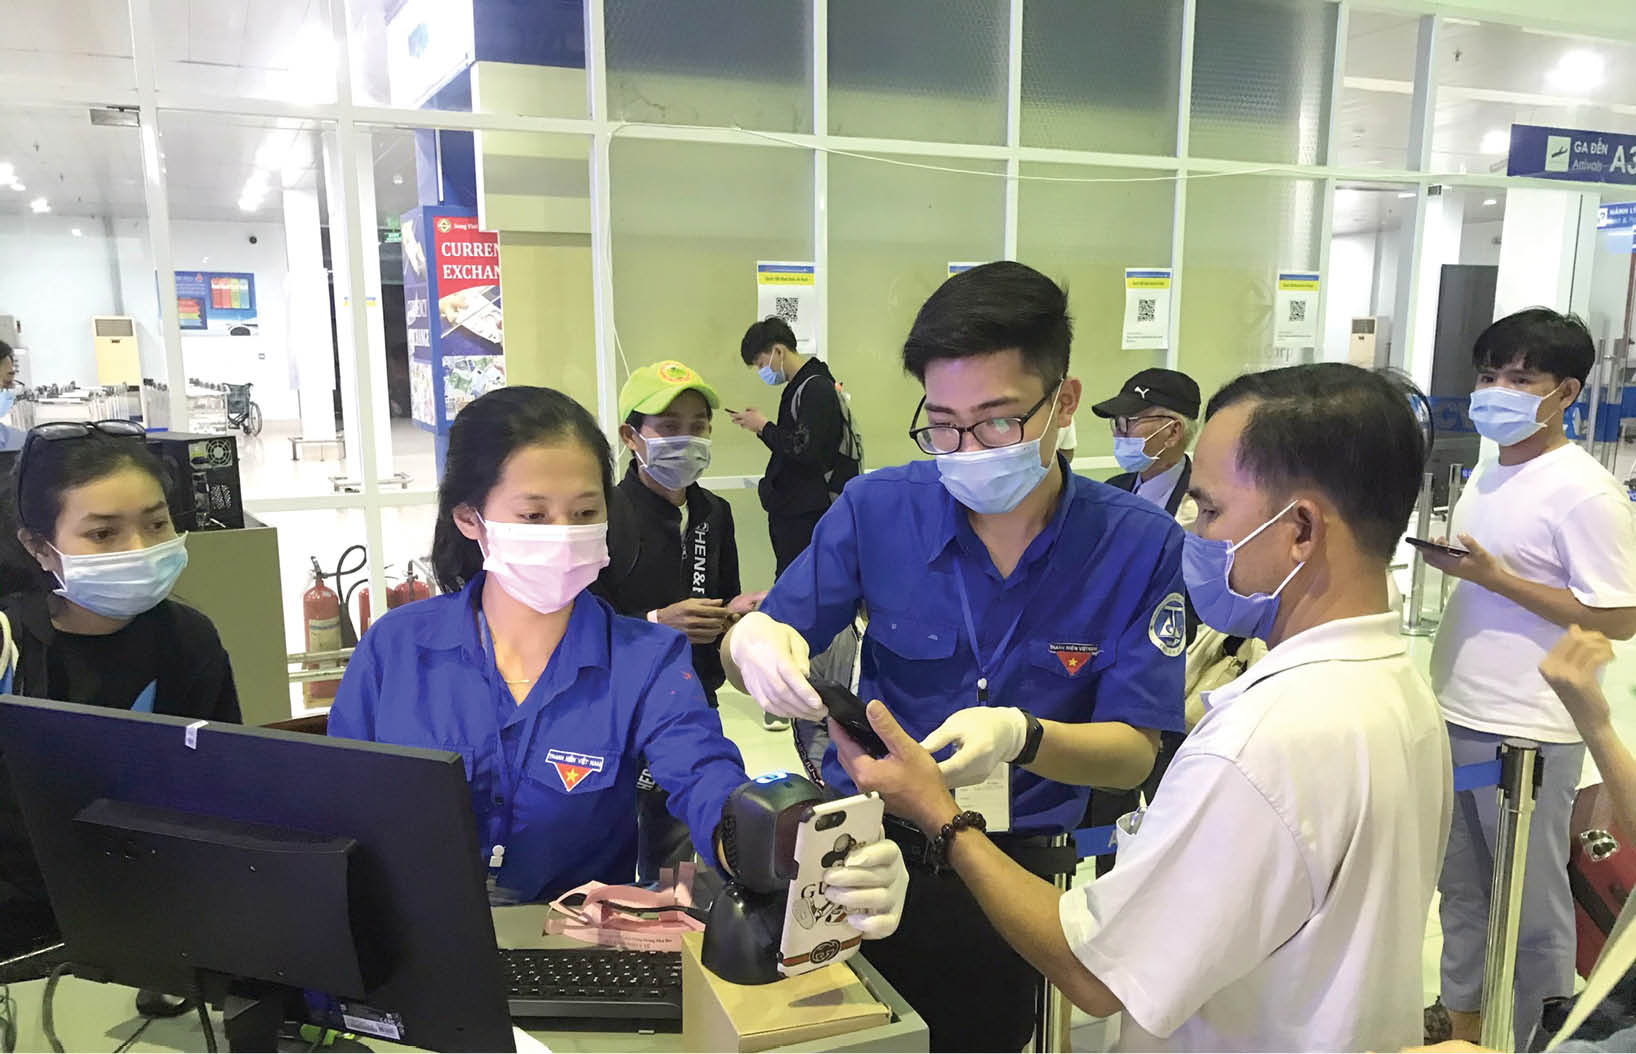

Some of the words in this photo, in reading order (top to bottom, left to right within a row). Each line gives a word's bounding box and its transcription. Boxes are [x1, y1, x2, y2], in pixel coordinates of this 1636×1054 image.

[1574, 141, 1588, 154] GA
[1591, 137, 1608, 155] ĐẾN
[1609, 144, 1636, 175] A3
